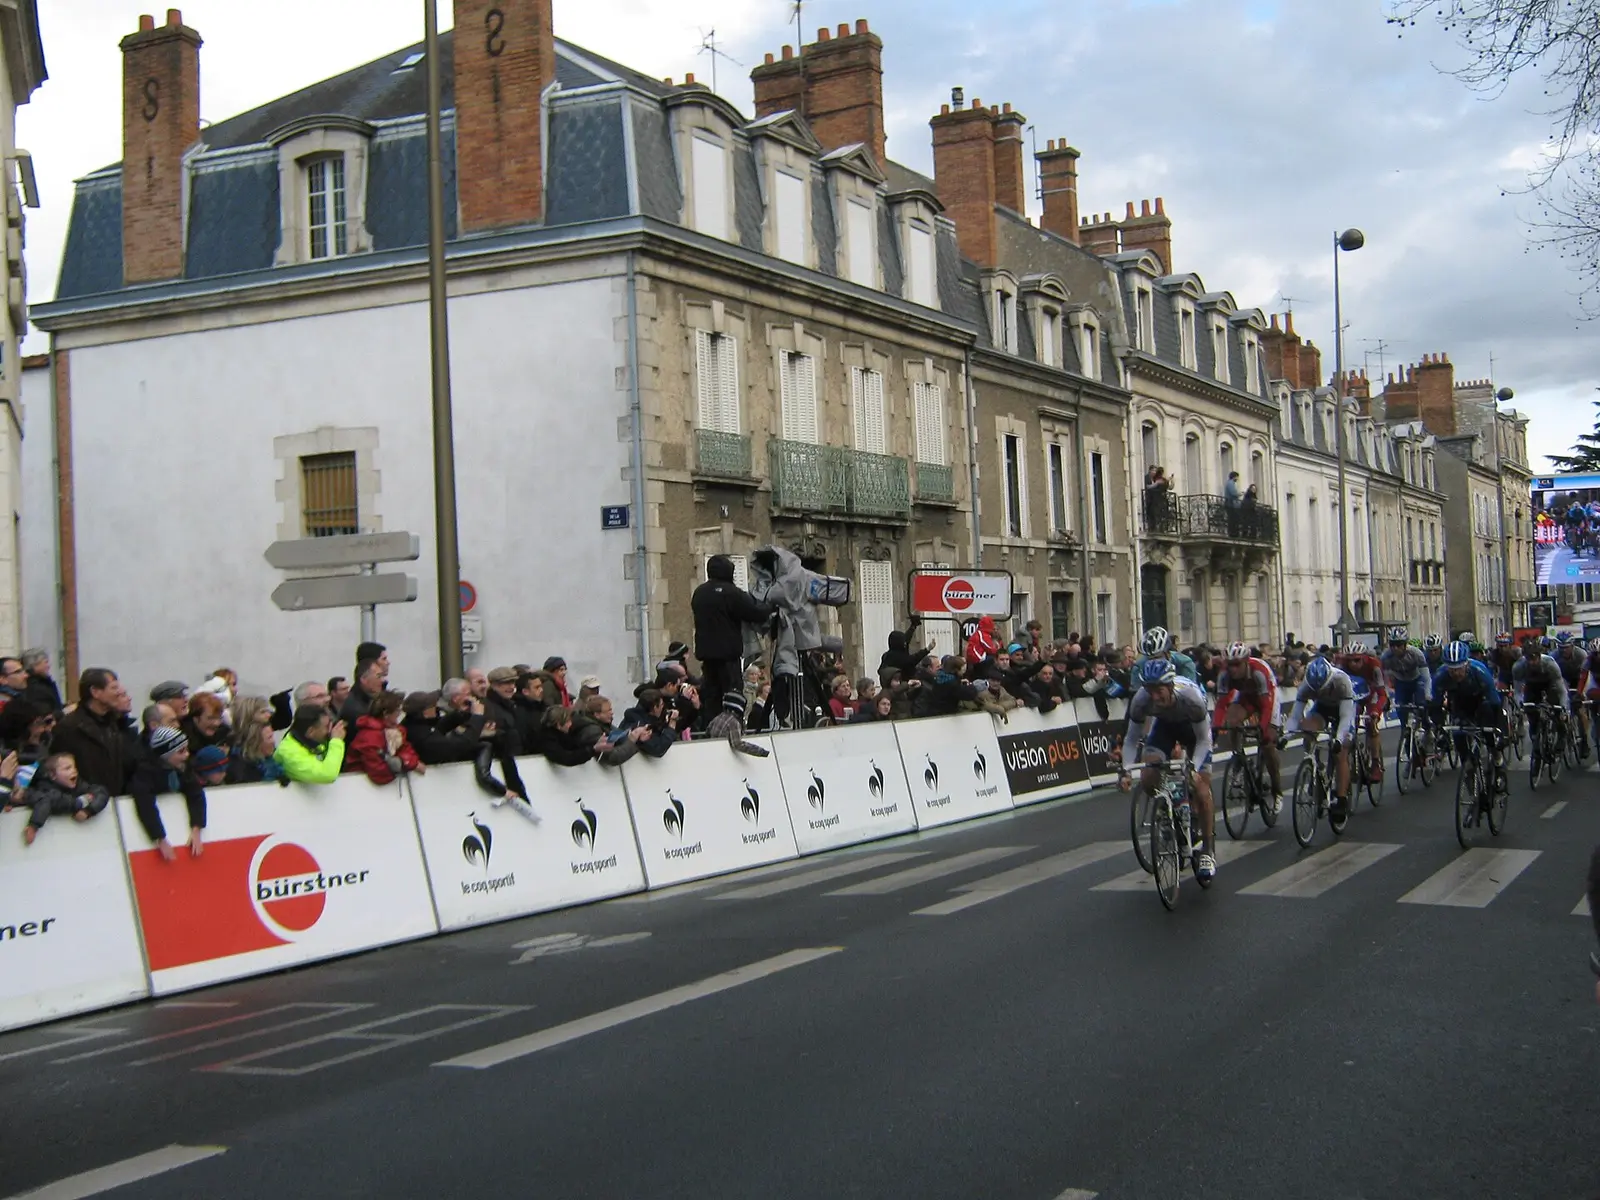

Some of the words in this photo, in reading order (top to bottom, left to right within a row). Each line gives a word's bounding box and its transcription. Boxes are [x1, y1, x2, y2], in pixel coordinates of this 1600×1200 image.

[944, 591, 996, 600] bürstner
[963, 622, 978, 637] 10
[1005, 740, 1048, 771] vision
[1047, 739, 1080, 769] plus
[875, 808, 885, 817] coq
[884, 803, 898, 816] sportif
[808, 819, 815, 829] le
[814, 820, 825, 830] coq
[824, 814, 840, 828] sportif
[741, 833, 748, 844] le
[748, 834, 760, 844] coq
[759, 828, 776, 843] sportif
[664, 848, 671, 859] le
[671, 848, 684, 859] coq
[683, 841, 702, 858] sportif
[571, 862, 580, 874] le
[580, 861, 594, 874] coq
[594, 854, 617, 872] sportif
[255, 867, 370, 903] bürstner
[461, 880, 470, 895] le
[471, 881, 488, 895] coq
[488, 872, 515, 892] sportif
